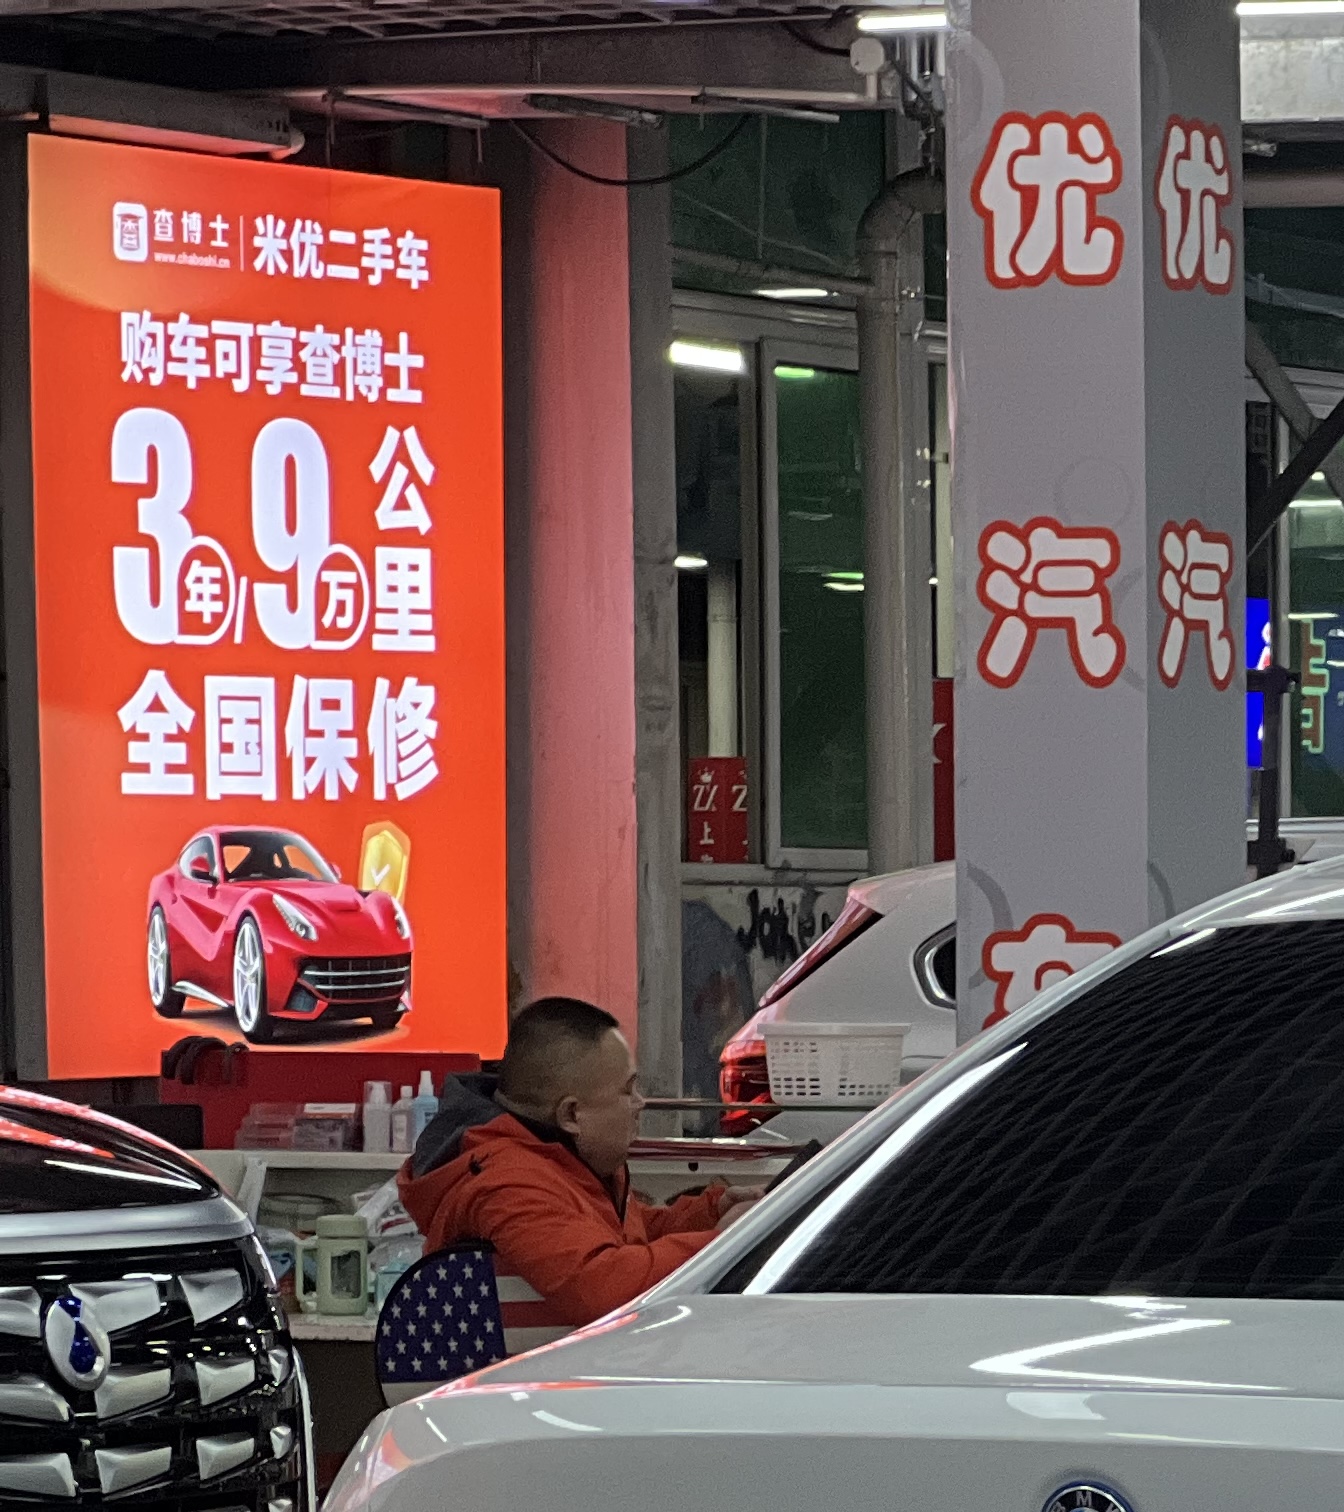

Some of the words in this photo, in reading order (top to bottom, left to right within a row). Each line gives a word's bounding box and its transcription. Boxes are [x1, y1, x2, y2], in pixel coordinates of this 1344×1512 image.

[153, 208, 230, 247] 查博士
[253, 215, 429, 289] 米优二手车
[120, 310, 425, 403] 购车可享查博士
[116, 669, 440, 801] 全国保修
